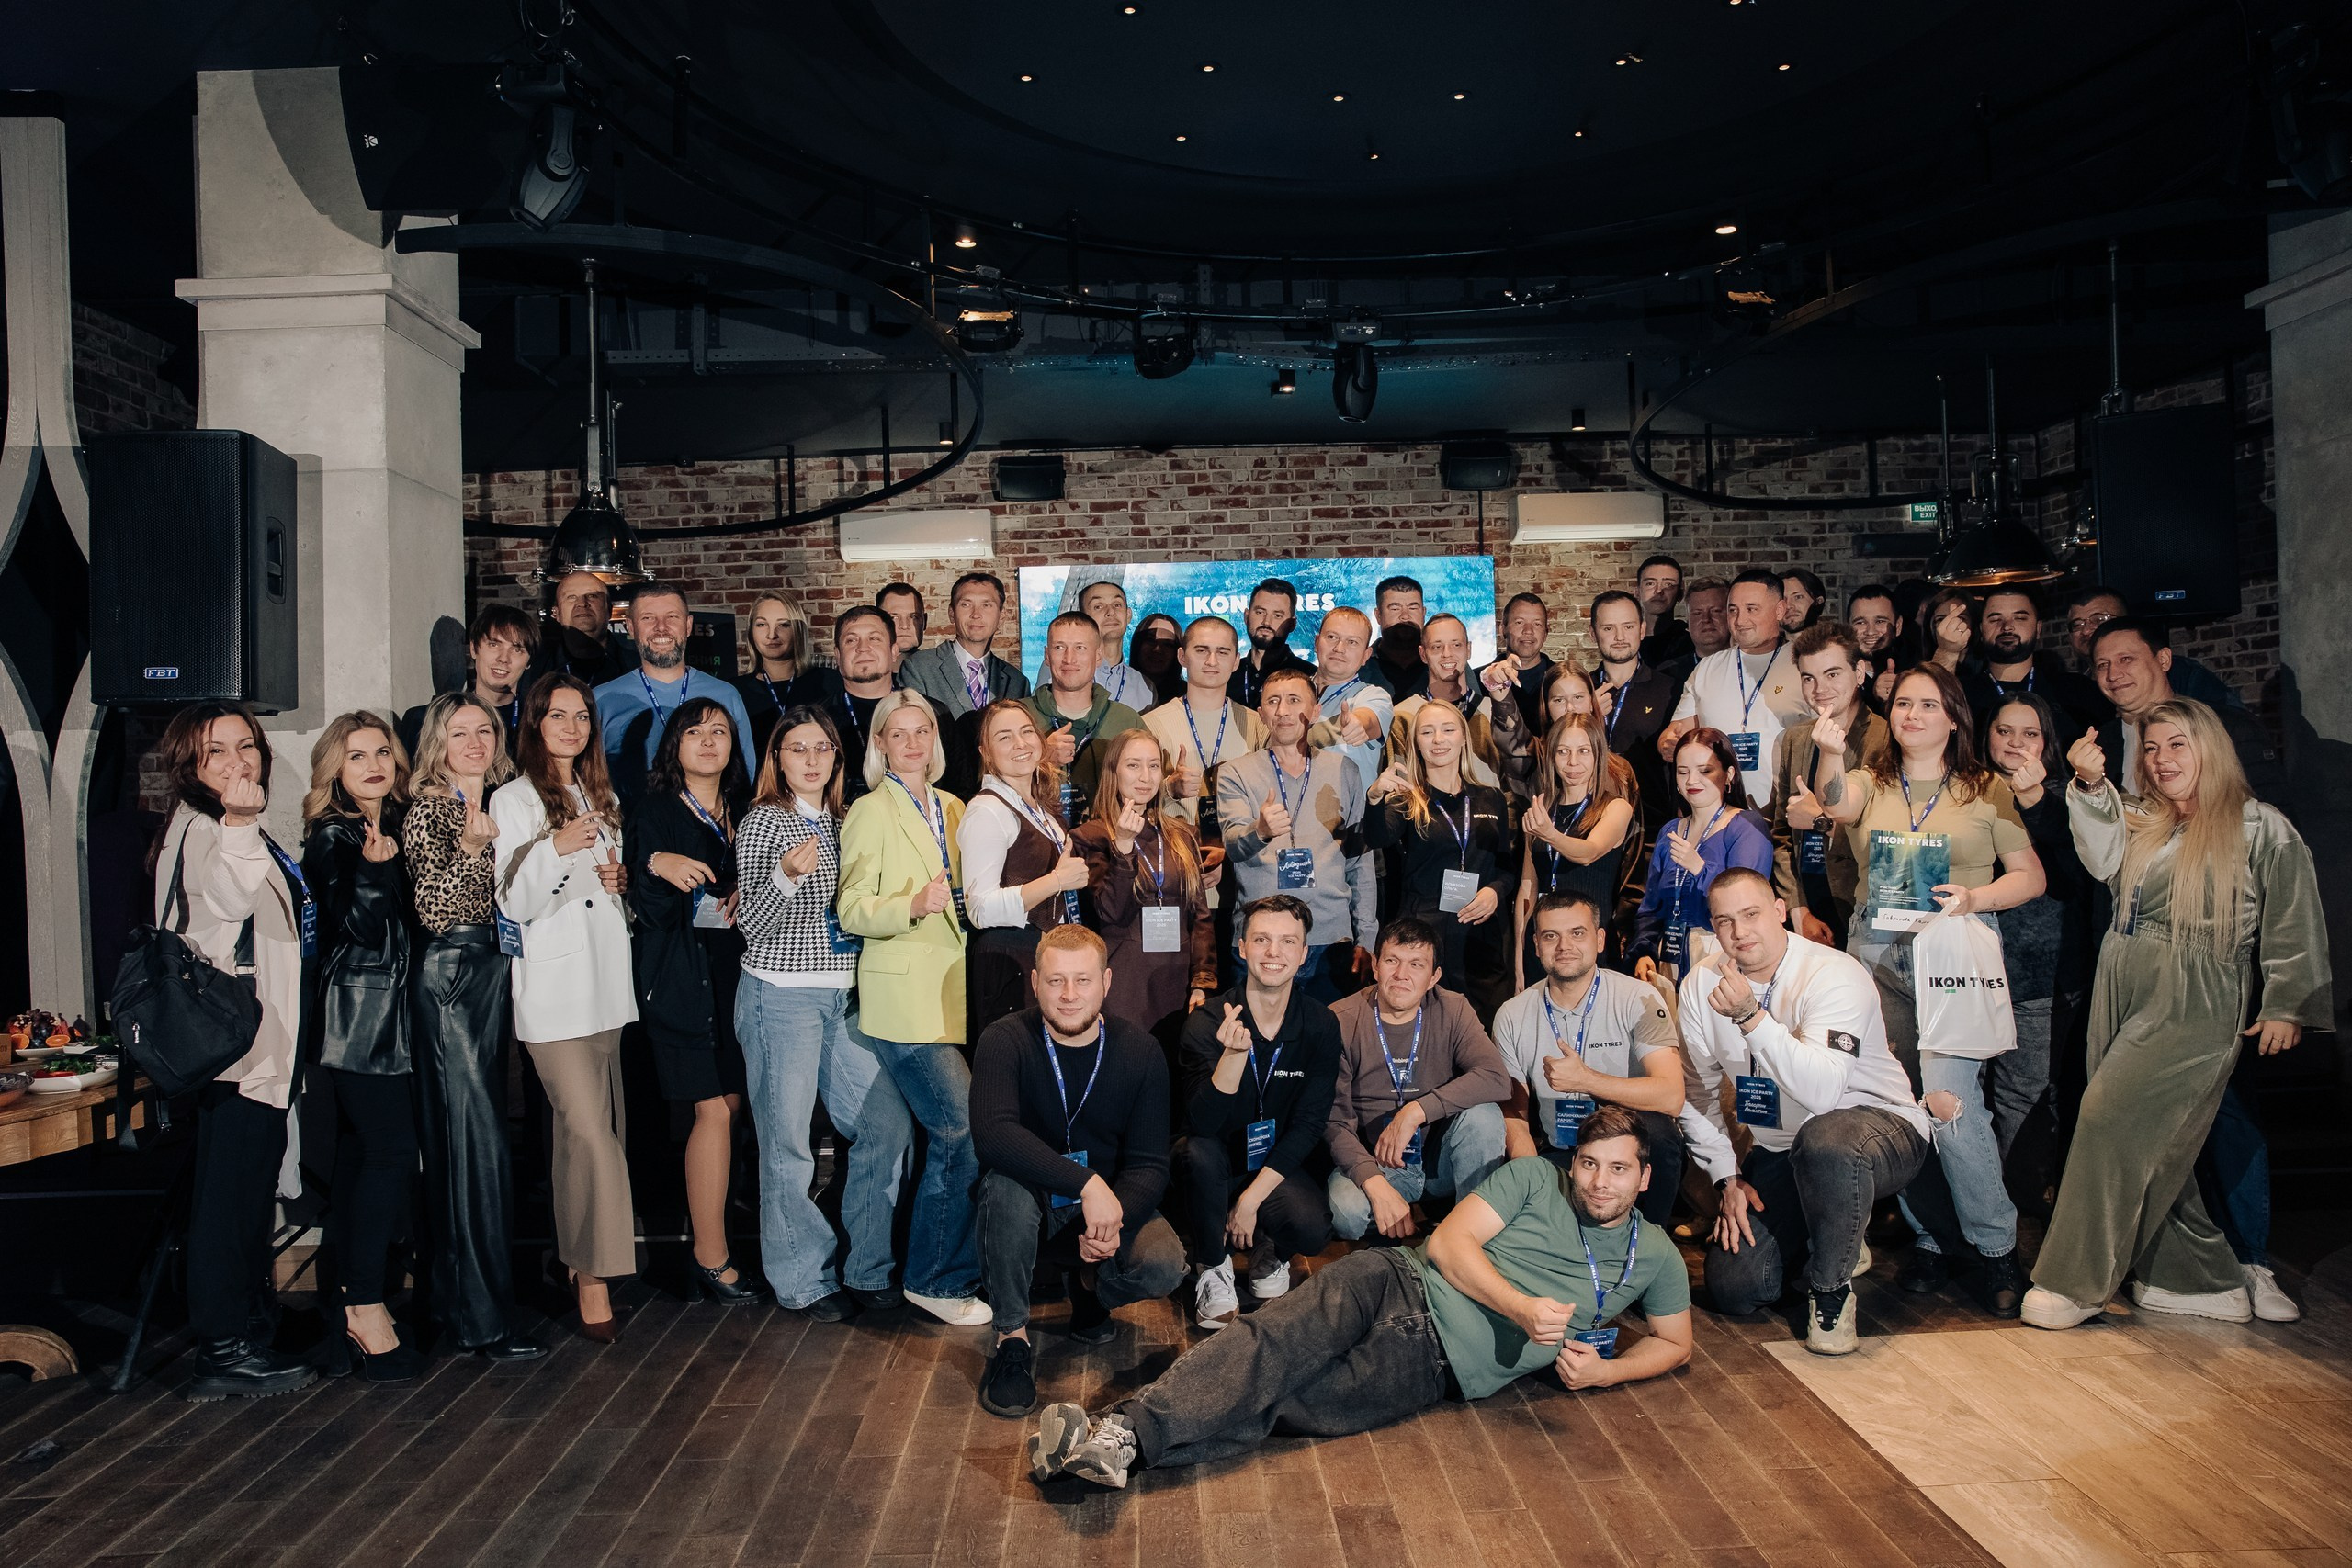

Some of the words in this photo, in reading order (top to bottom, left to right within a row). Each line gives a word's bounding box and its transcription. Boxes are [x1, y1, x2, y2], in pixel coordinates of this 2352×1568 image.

[1184, 596, 1250, 615] IKON
[148, 669, 175, 677] FBT
[1878, 835, 1905, 845] IKON
[1908, 838, 1943, 848] TYRES
[1929, 976, 1966, 987] IKON
[1970, 976, 2005, 989] TYES
